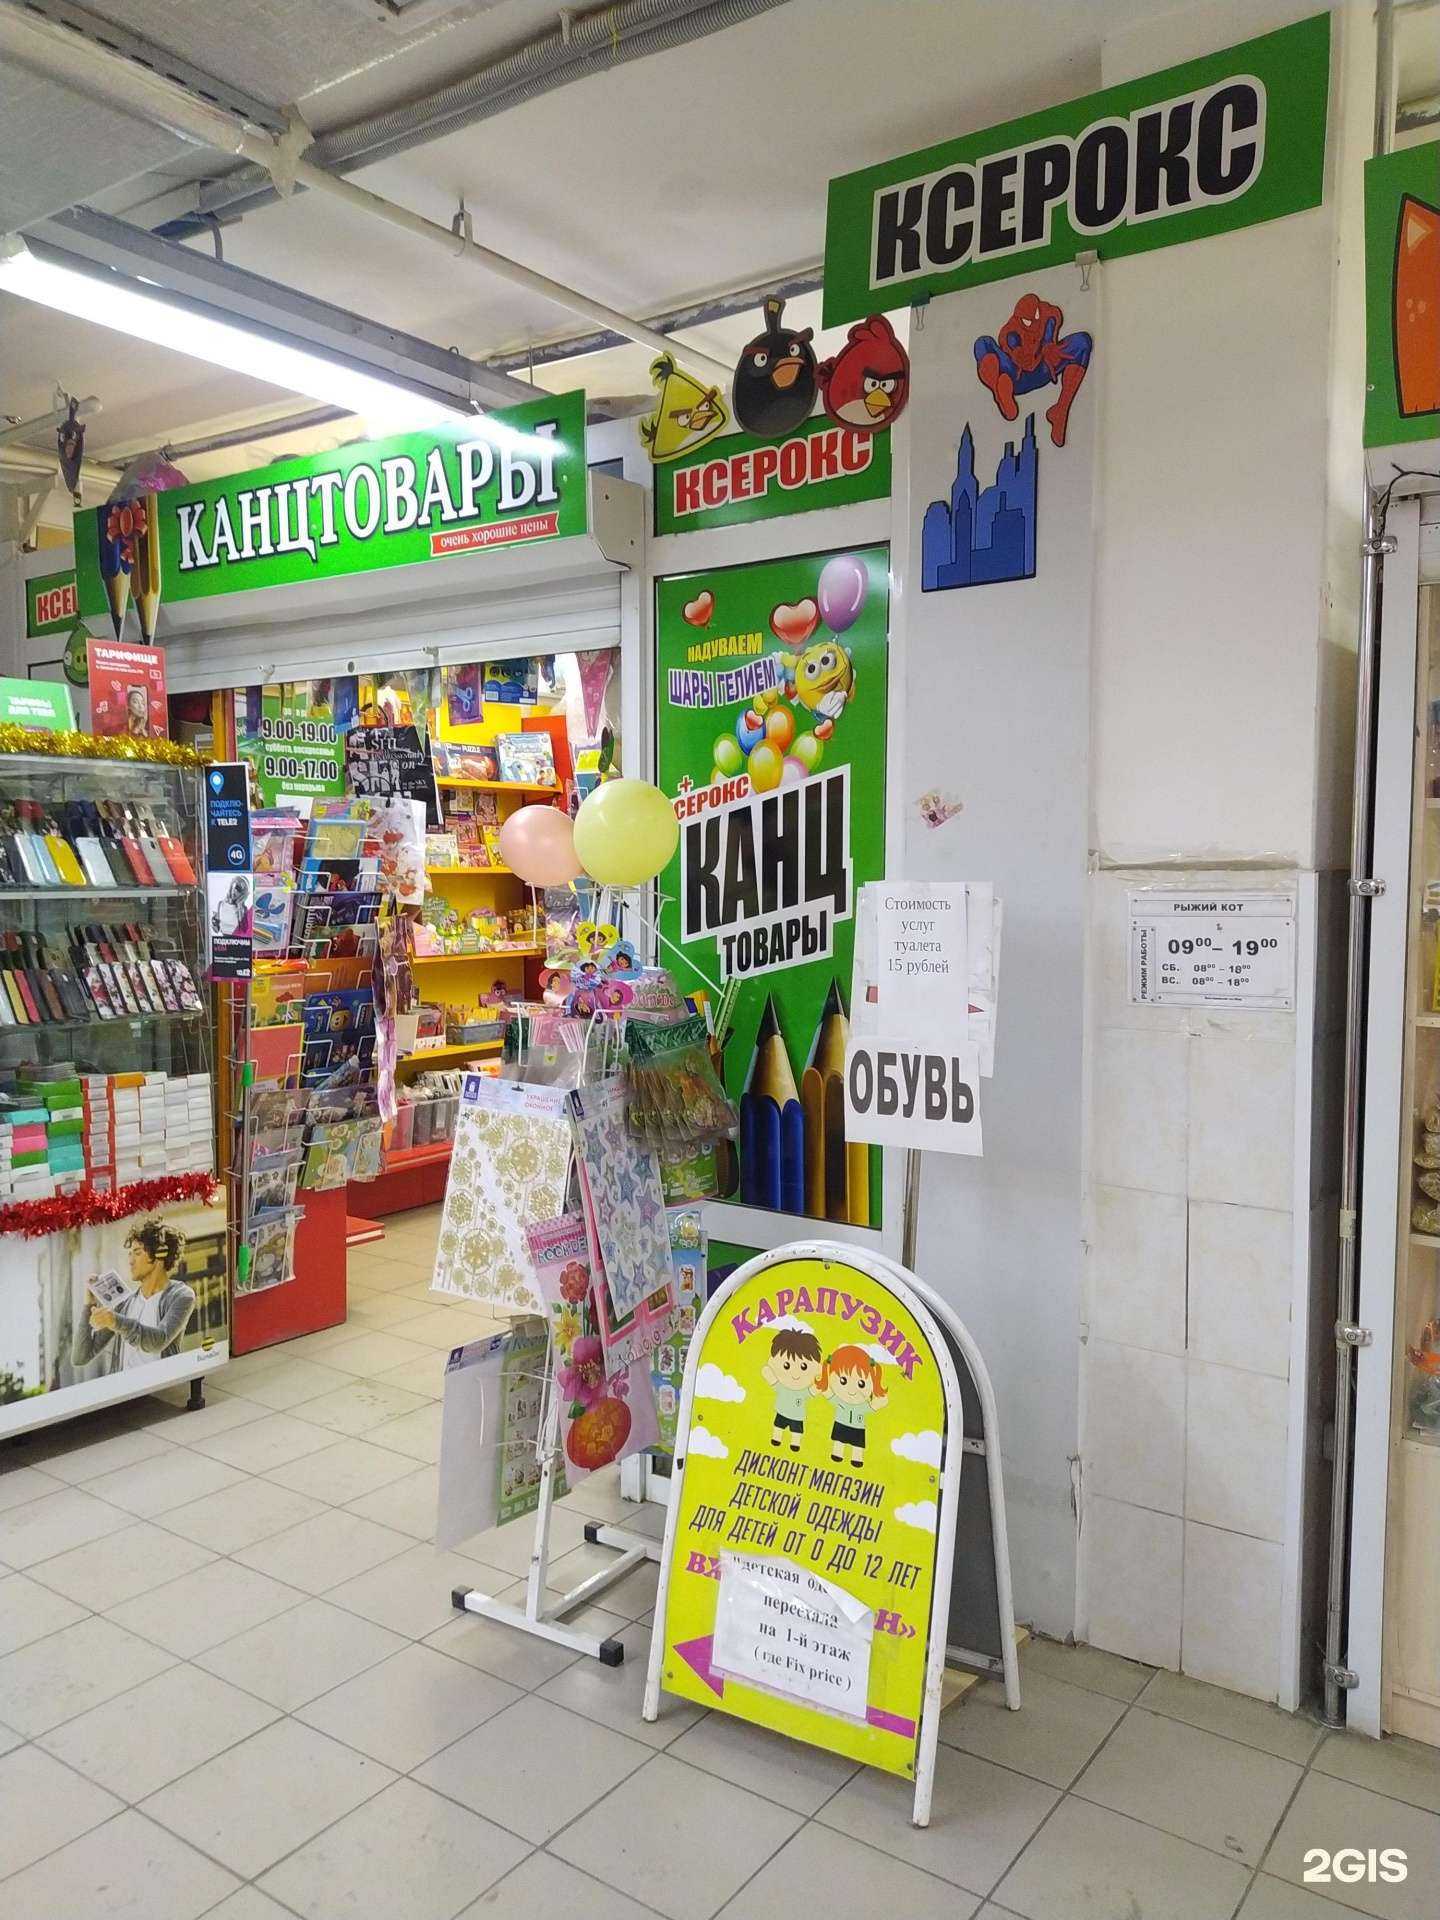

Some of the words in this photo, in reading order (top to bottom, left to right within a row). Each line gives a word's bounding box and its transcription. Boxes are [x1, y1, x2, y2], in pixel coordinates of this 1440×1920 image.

[875, 83, 1259, 281] КСЕРОКС
[676, 430, 873, 513] КСЕРОКС
[177, 423, 558, 569] КАНЦТОВАРЫ
[440, 535, 470, 548] очень
[471, 525, 518, 544] хорошие
[519, 519, 549, 535] цены
[36, 585, 77, 623] КСЕ
[687, 631, 763, 663] НАДУВАЕМ
[669, 669, 714, 707] ШАРЫ
[716, 656, 777, 705] ГЕЛИЕМ
[262, 717, 338, 745] 9.00-19.00
[265, 755, 338, 780] 9.00-17.00
[230, 849, 244, 860] 4G
[686, 773, 847, 936] КАНЦ
[884, 895, 952, 912] Стоимость
[1173, 903, 1218, 912] РЫЖИЙ
[1221, 903, 1244, 912] КОТ
[722, 910, 828, 976] ТОВАРЫ
[901, 919, 936, 935] услуг
[893, 939, 943, 954] туалета
[1140, 929, 1148, 966] РАБОТЫ
[887, 957, 903, 973] 15
[906, 958, 950, 976] рублей
[1161, 963, 1180, 972] СБ.
[1161, 976, 1179, 985] ВС.
[1140, 967, 1148, 1000] РЕЖИМ
[849, 1049, 975, 1124] ОБУВЬ
[731, 1286, 923, 1381] КАРАПУЗИК
[733, 1449, 810, 1487] ДИСКОНТ
[808, 1467, 885, 1508] МАГАЗИН
[729, 1482, 802, 1519] ДЕТСКОЙ
[806, 1501, 884, 1545] ОДЕЖДЫ
[688, 1504, 727, 1533] ДЛЯ
[727, 1515, 779, 1548] ДЕТЕЙ
[783, 1530, 807, 1556] ОТ
[826, 1543, 857, 1574] ДО
[863, 1552, 884, 1580] 12
[887, 1560, 923, 1591] ЛЕТ
[685, 1551, 721, 1581] ВХ
[759, 1622, 777, 1637] на
[786, 1627, 808, 1648] 1-й
[812, 1640, 852, 1662] этаж
[786, 1655, 805, 1674] Fix
